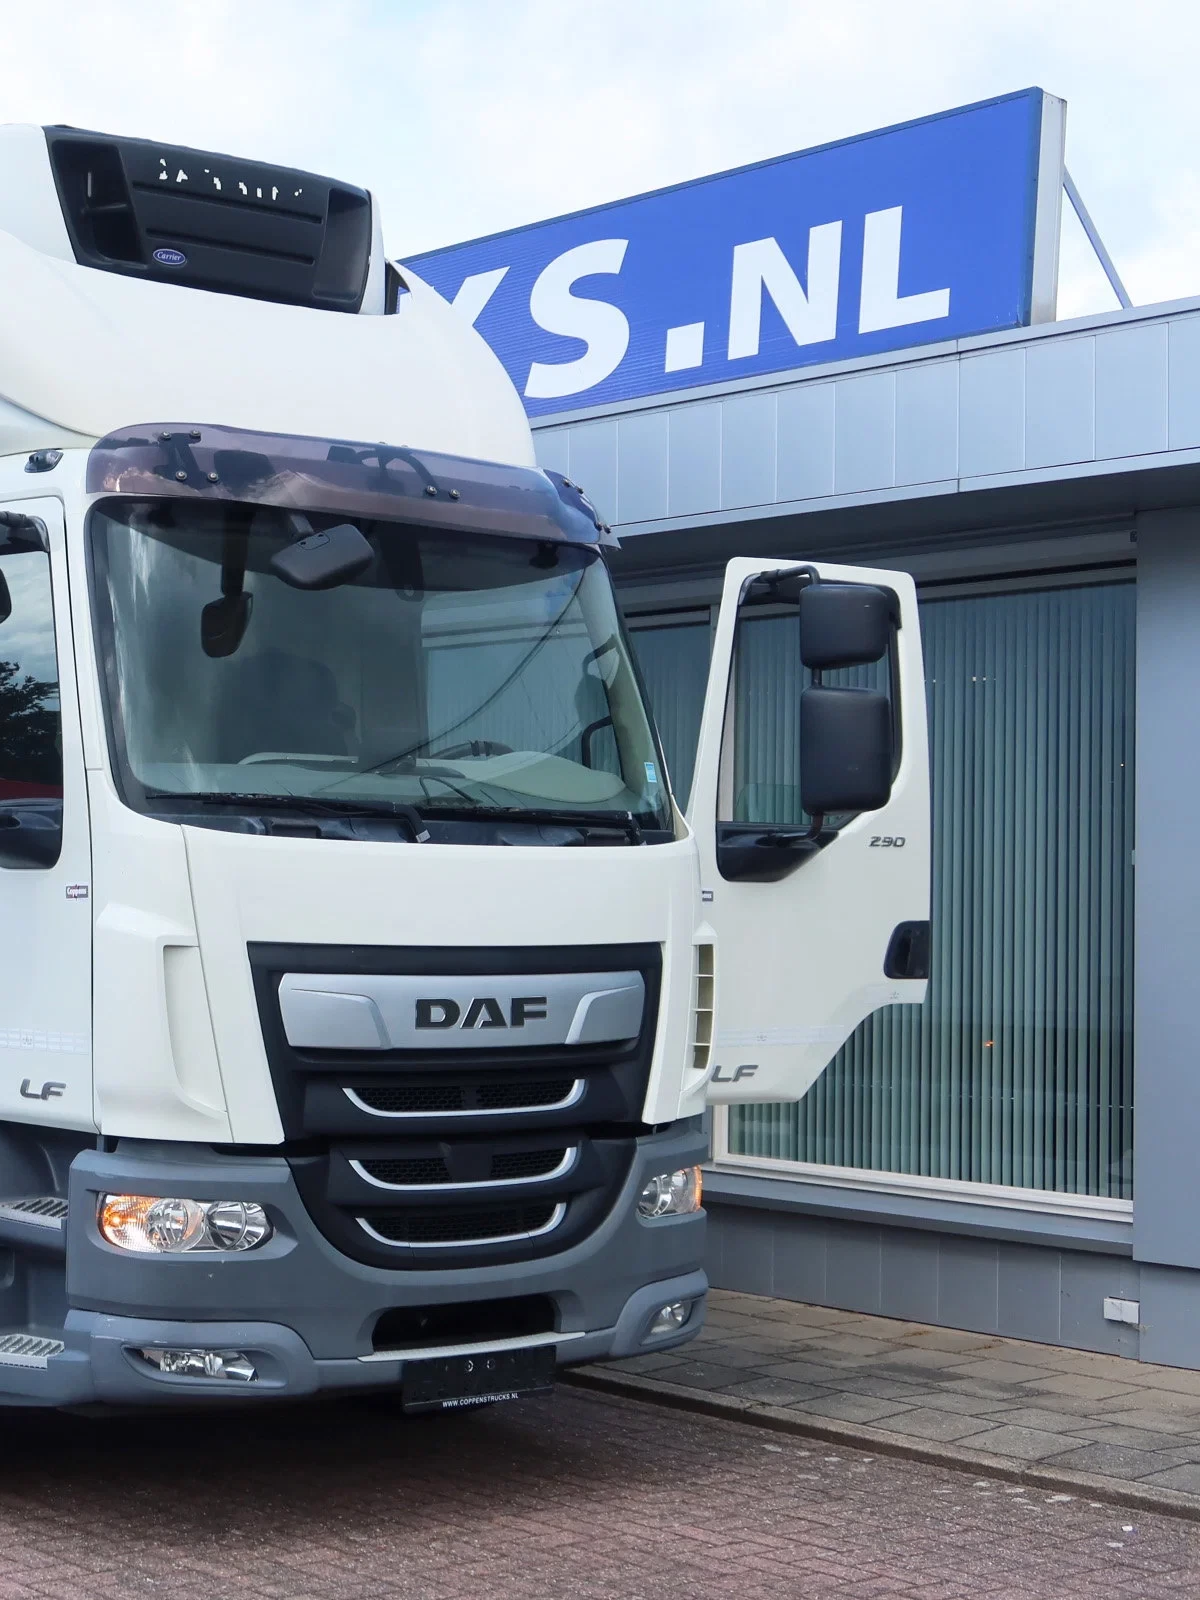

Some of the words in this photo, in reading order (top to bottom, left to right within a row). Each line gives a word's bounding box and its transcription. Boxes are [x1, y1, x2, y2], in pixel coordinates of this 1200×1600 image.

[157, 251, 182, 261] Carrier
[869, 836, 906, 848] 290
[415, 996, 548, 1030] DAF
[711, 1065, 759, 1083] LF
[20, 1078, 67, 1101] LF
